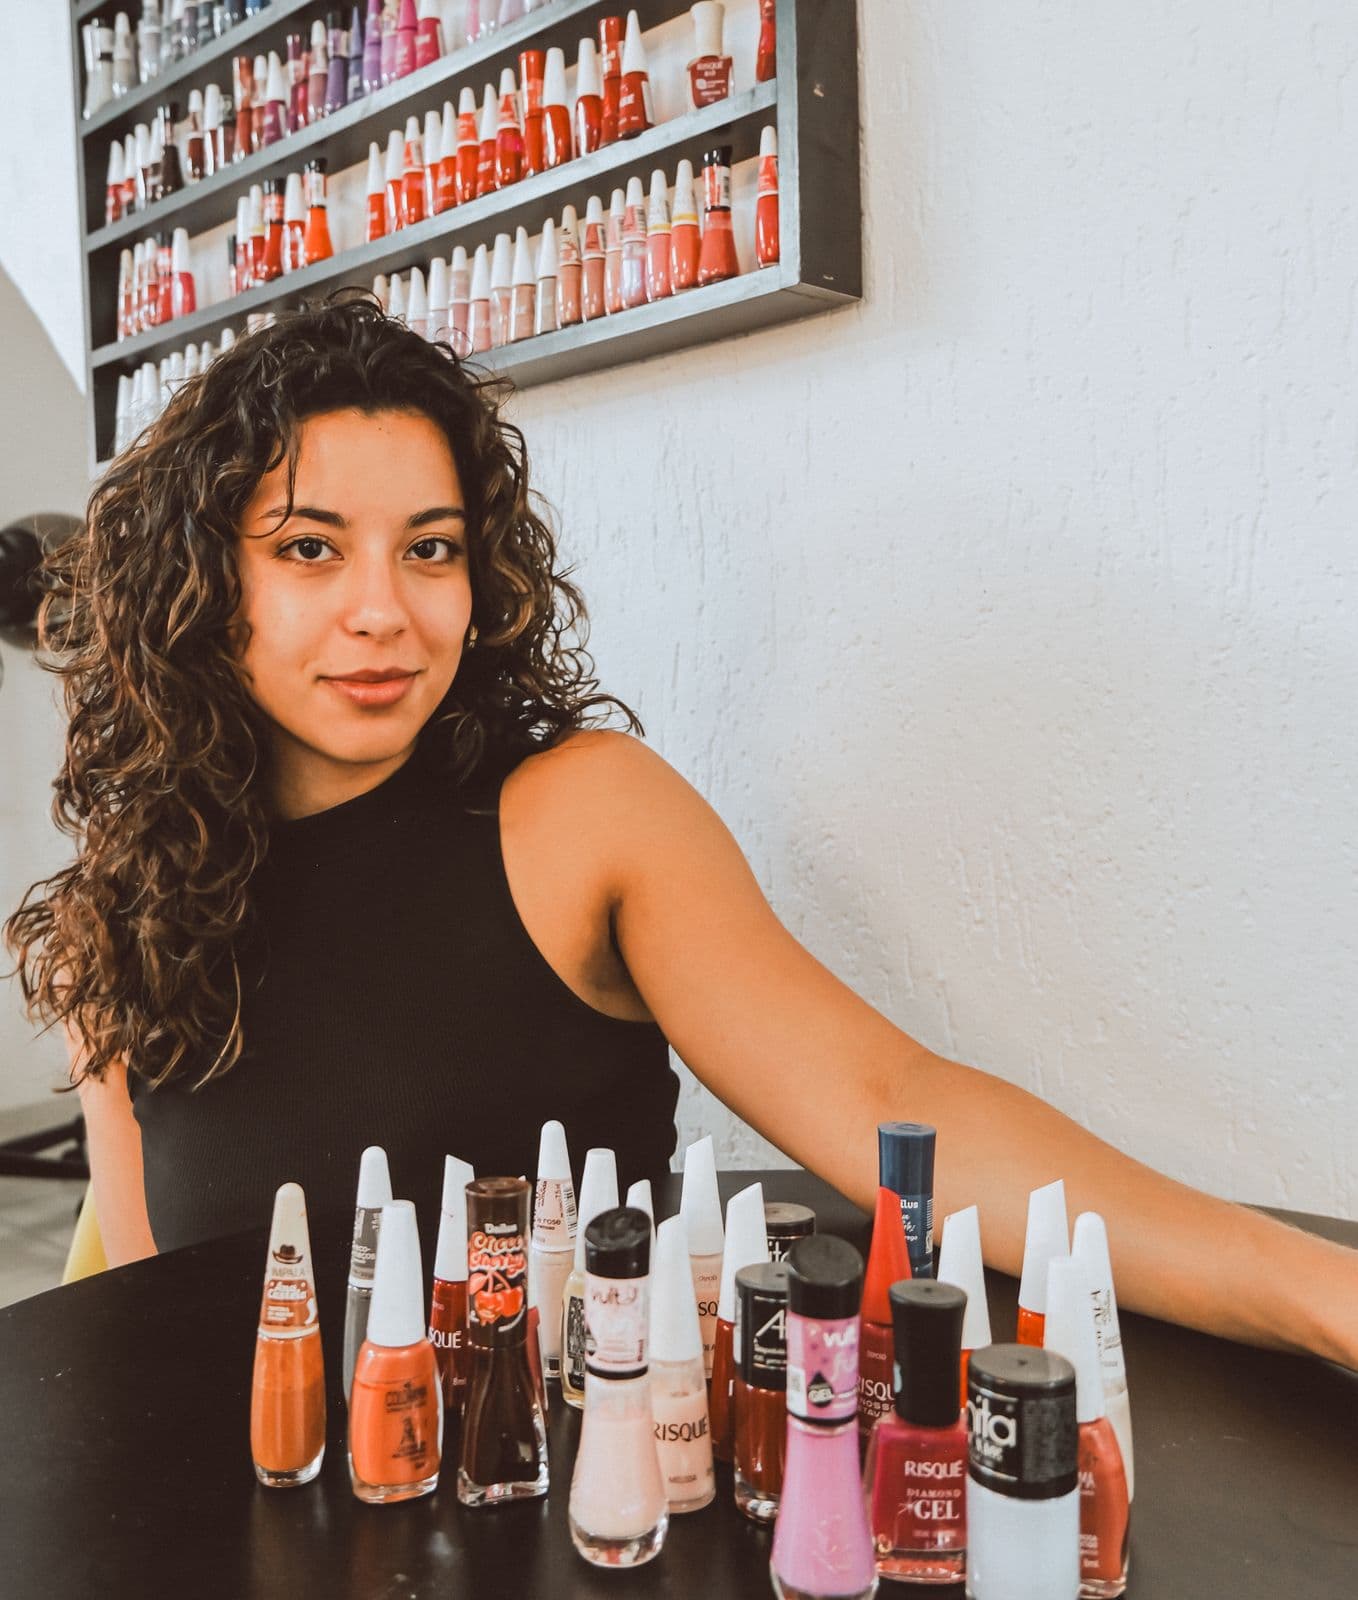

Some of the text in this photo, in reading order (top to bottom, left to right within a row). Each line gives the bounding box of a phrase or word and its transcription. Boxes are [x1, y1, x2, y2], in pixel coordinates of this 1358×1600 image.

[428, 1327, 462, 1348] SQUÉ
[904, 1460, 963, 1479] RISQUÉ
[906, 1487, 962, 1498] DIAMOND
[914, 1500, 960, 1520] GEL
